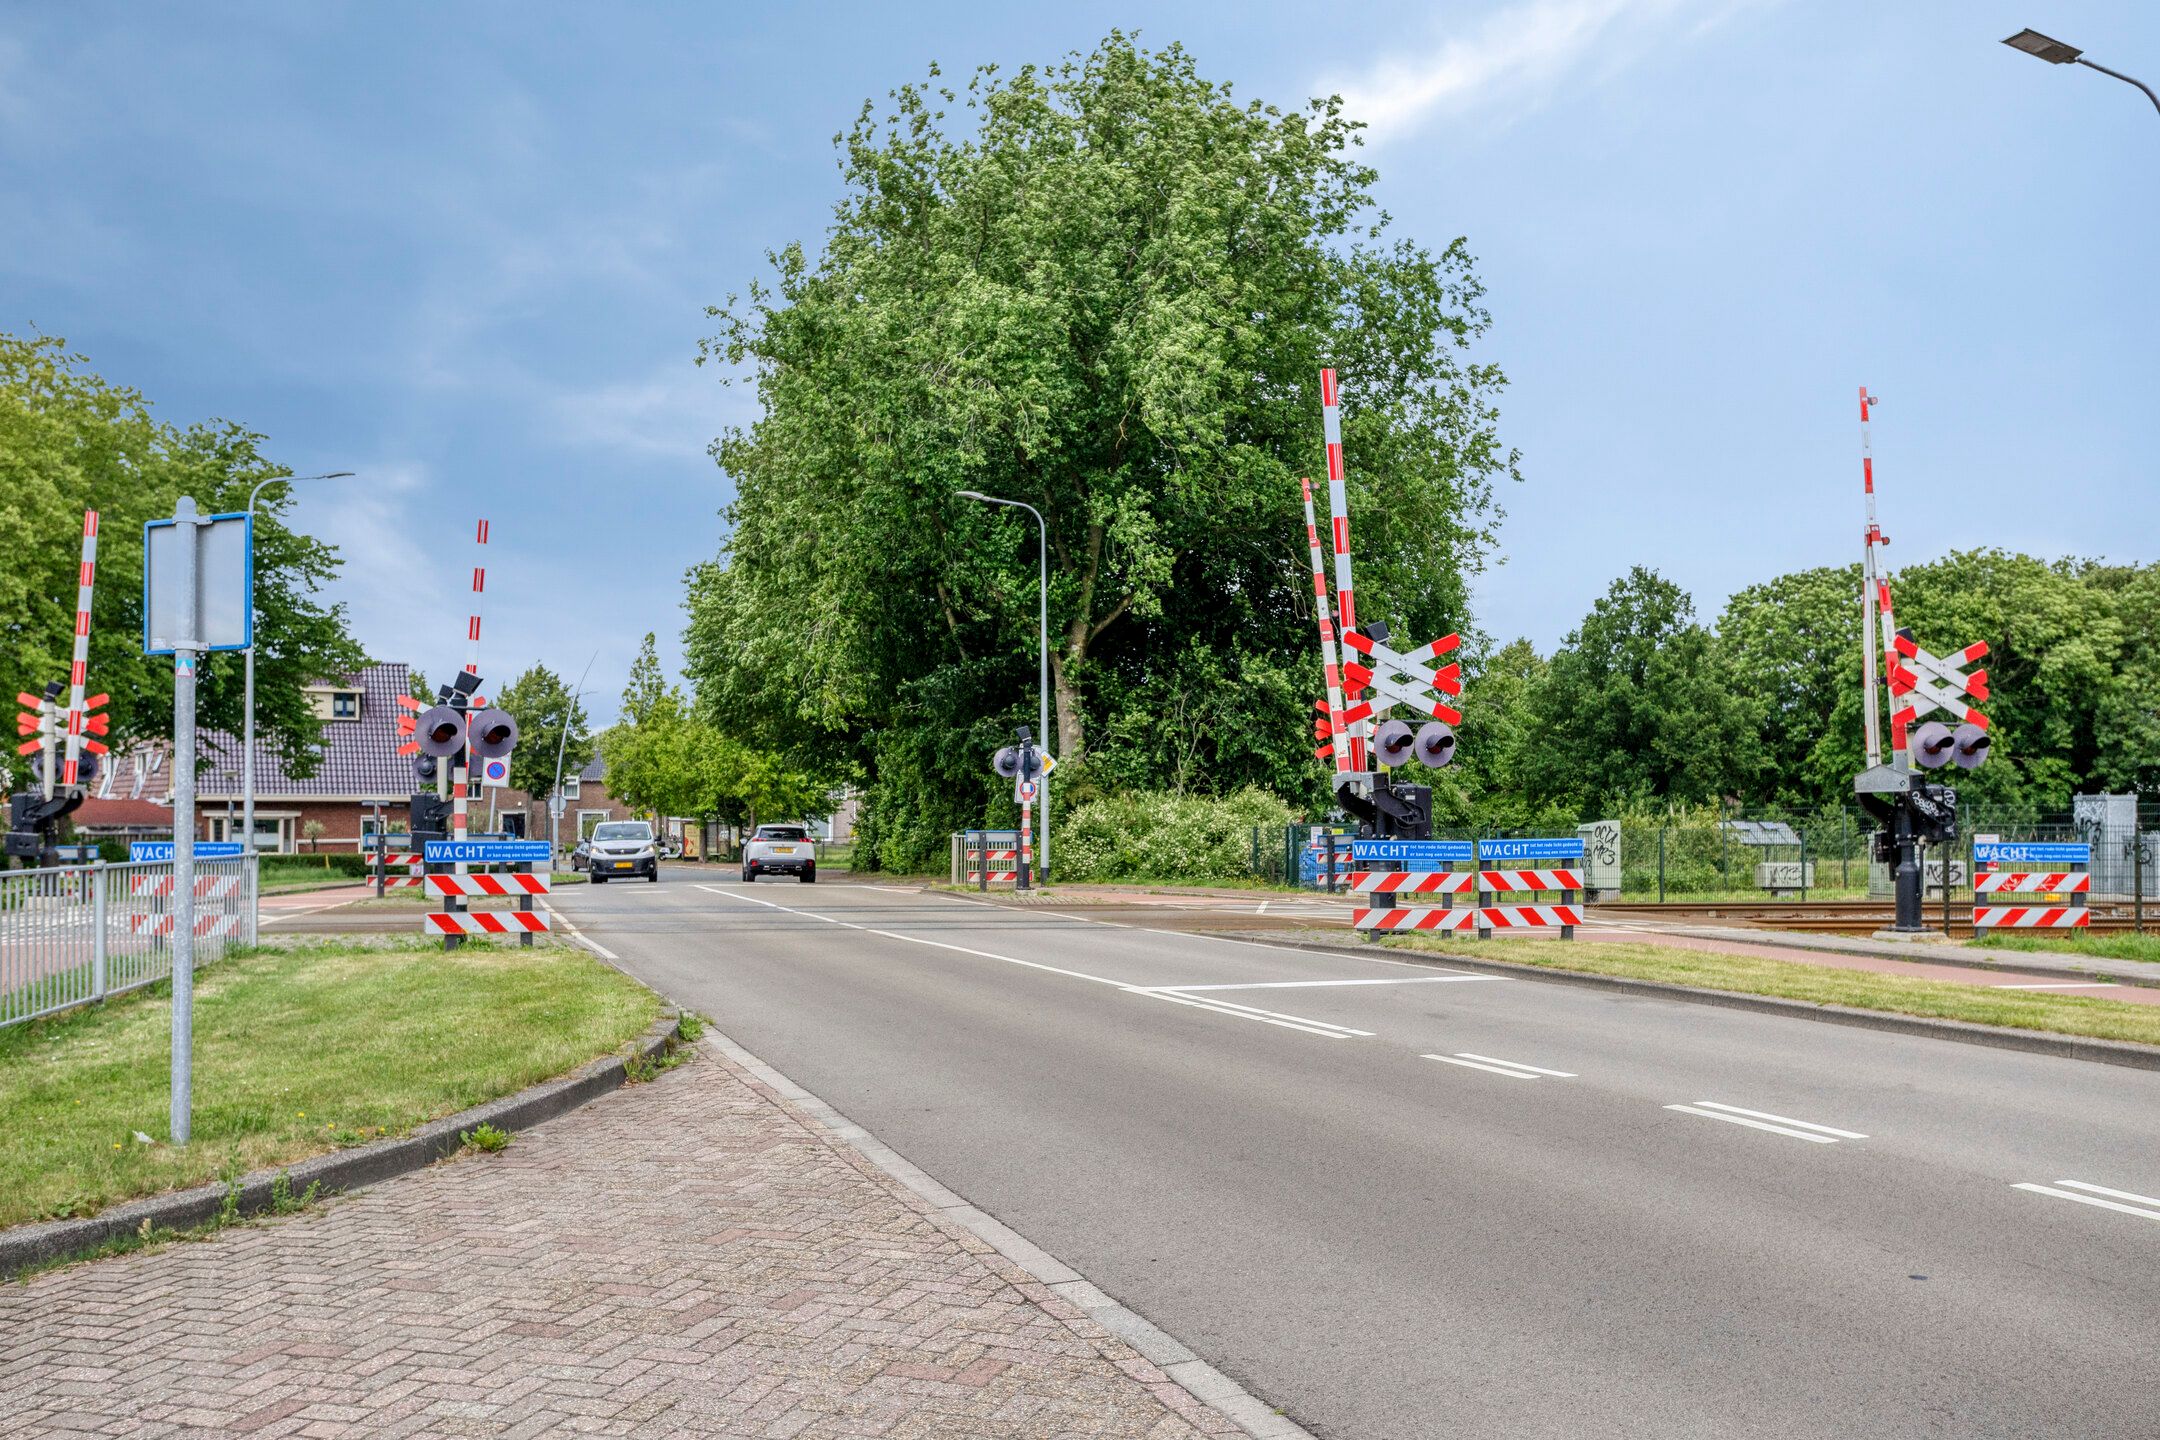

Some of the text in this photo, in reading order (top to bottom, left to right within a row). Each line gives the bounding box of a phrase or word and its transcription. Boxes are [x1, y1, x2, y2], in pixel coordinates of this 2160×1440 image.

[132, 846, 174, 859] WACH
[427, 845, 486, 858] WACHT
[1354, 844, 1409, 857] WACHT
[1481, 843, 1529, 856] WACHT
[1976, 846, 2029, 859] WACHT
